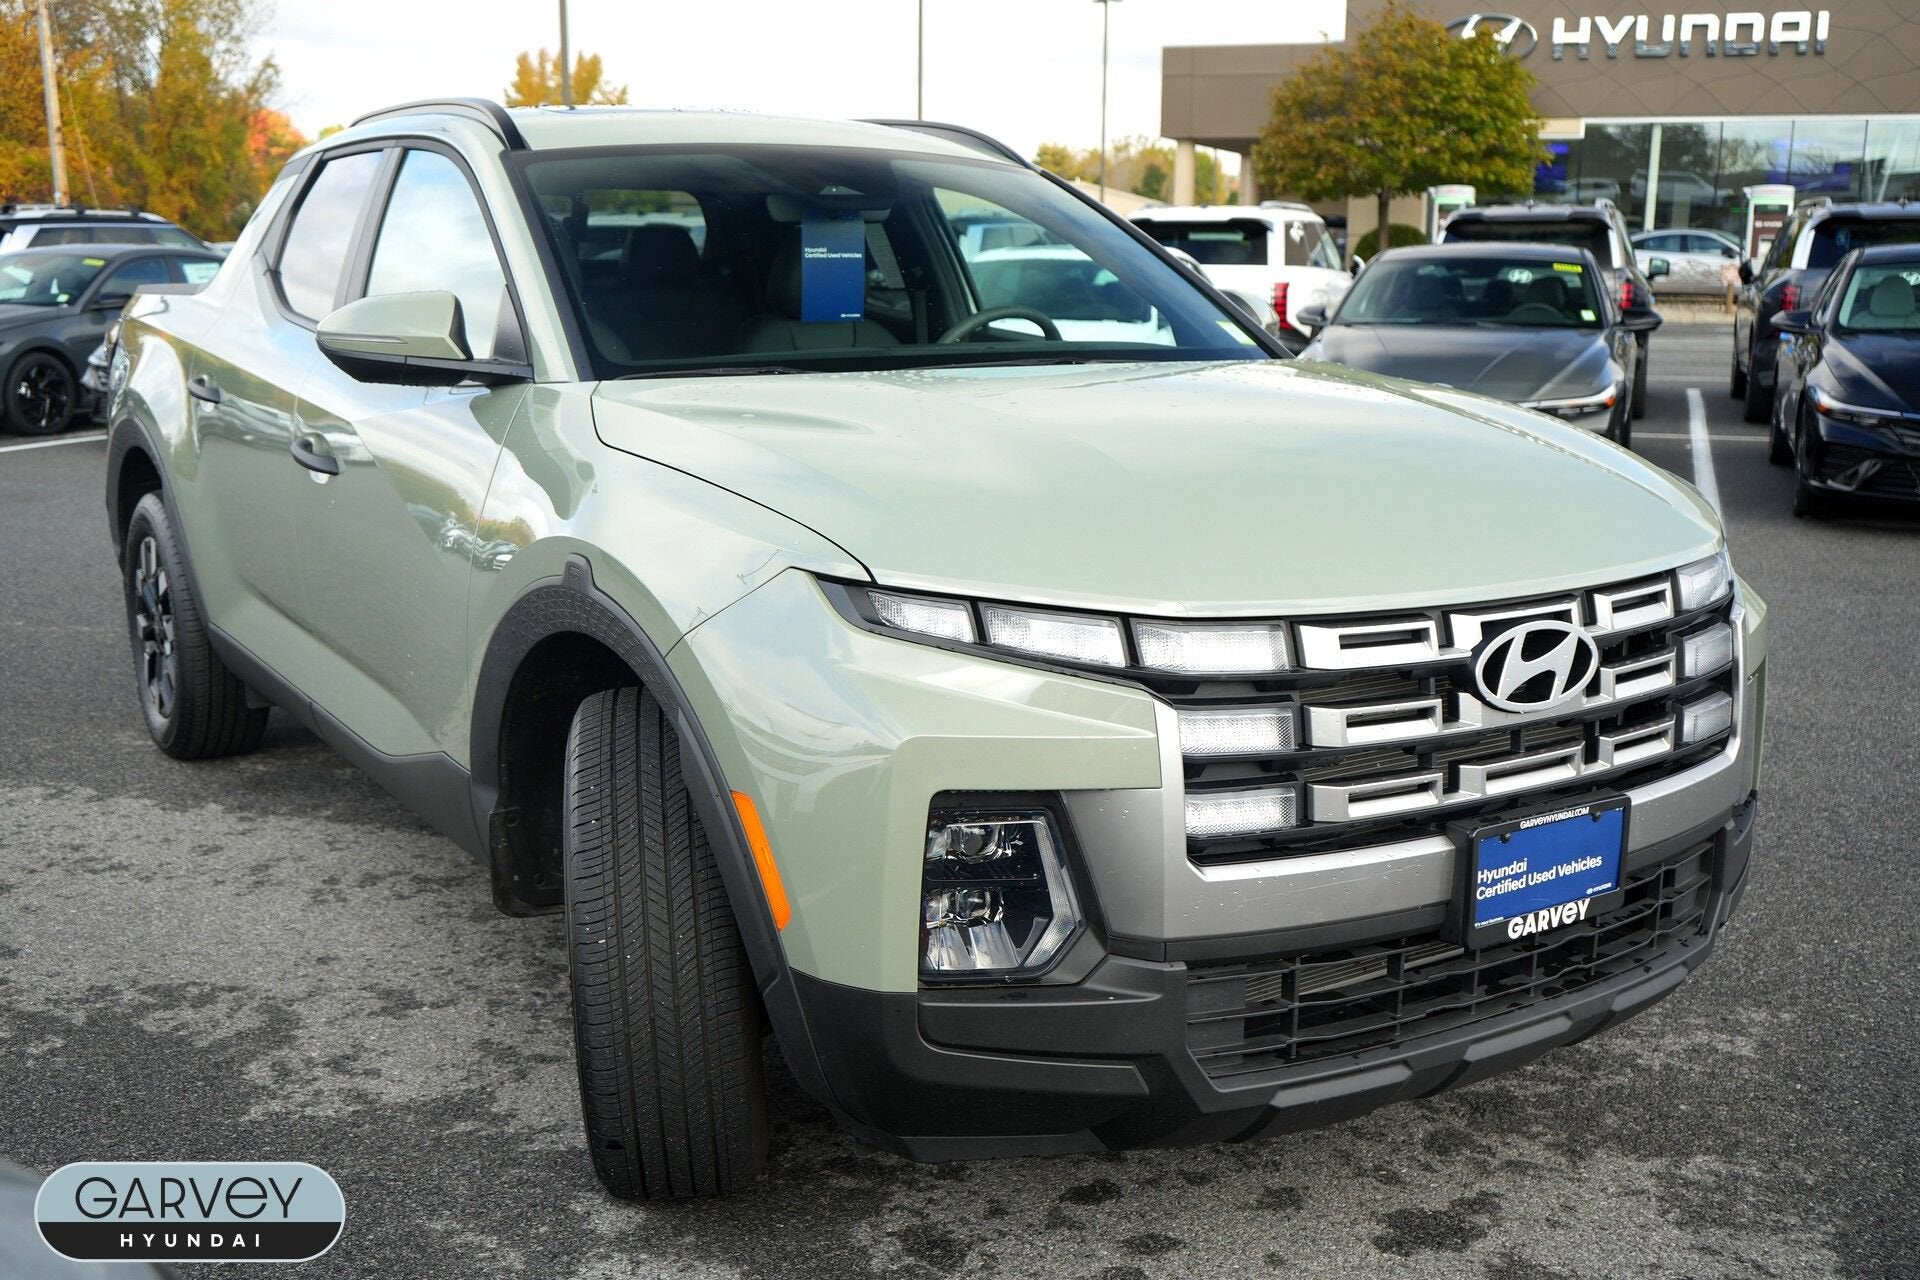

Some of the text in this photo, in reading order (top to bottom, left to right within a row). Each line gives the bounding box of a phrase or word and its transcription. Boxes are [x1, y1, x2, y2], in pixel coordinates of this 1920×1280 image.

[1552, 10, 1831, 60] HYUNDAI
[1476, 855, 1602, 900] Certified Used Vehicles
[1477, 858, 1527, 884] Hyundai
